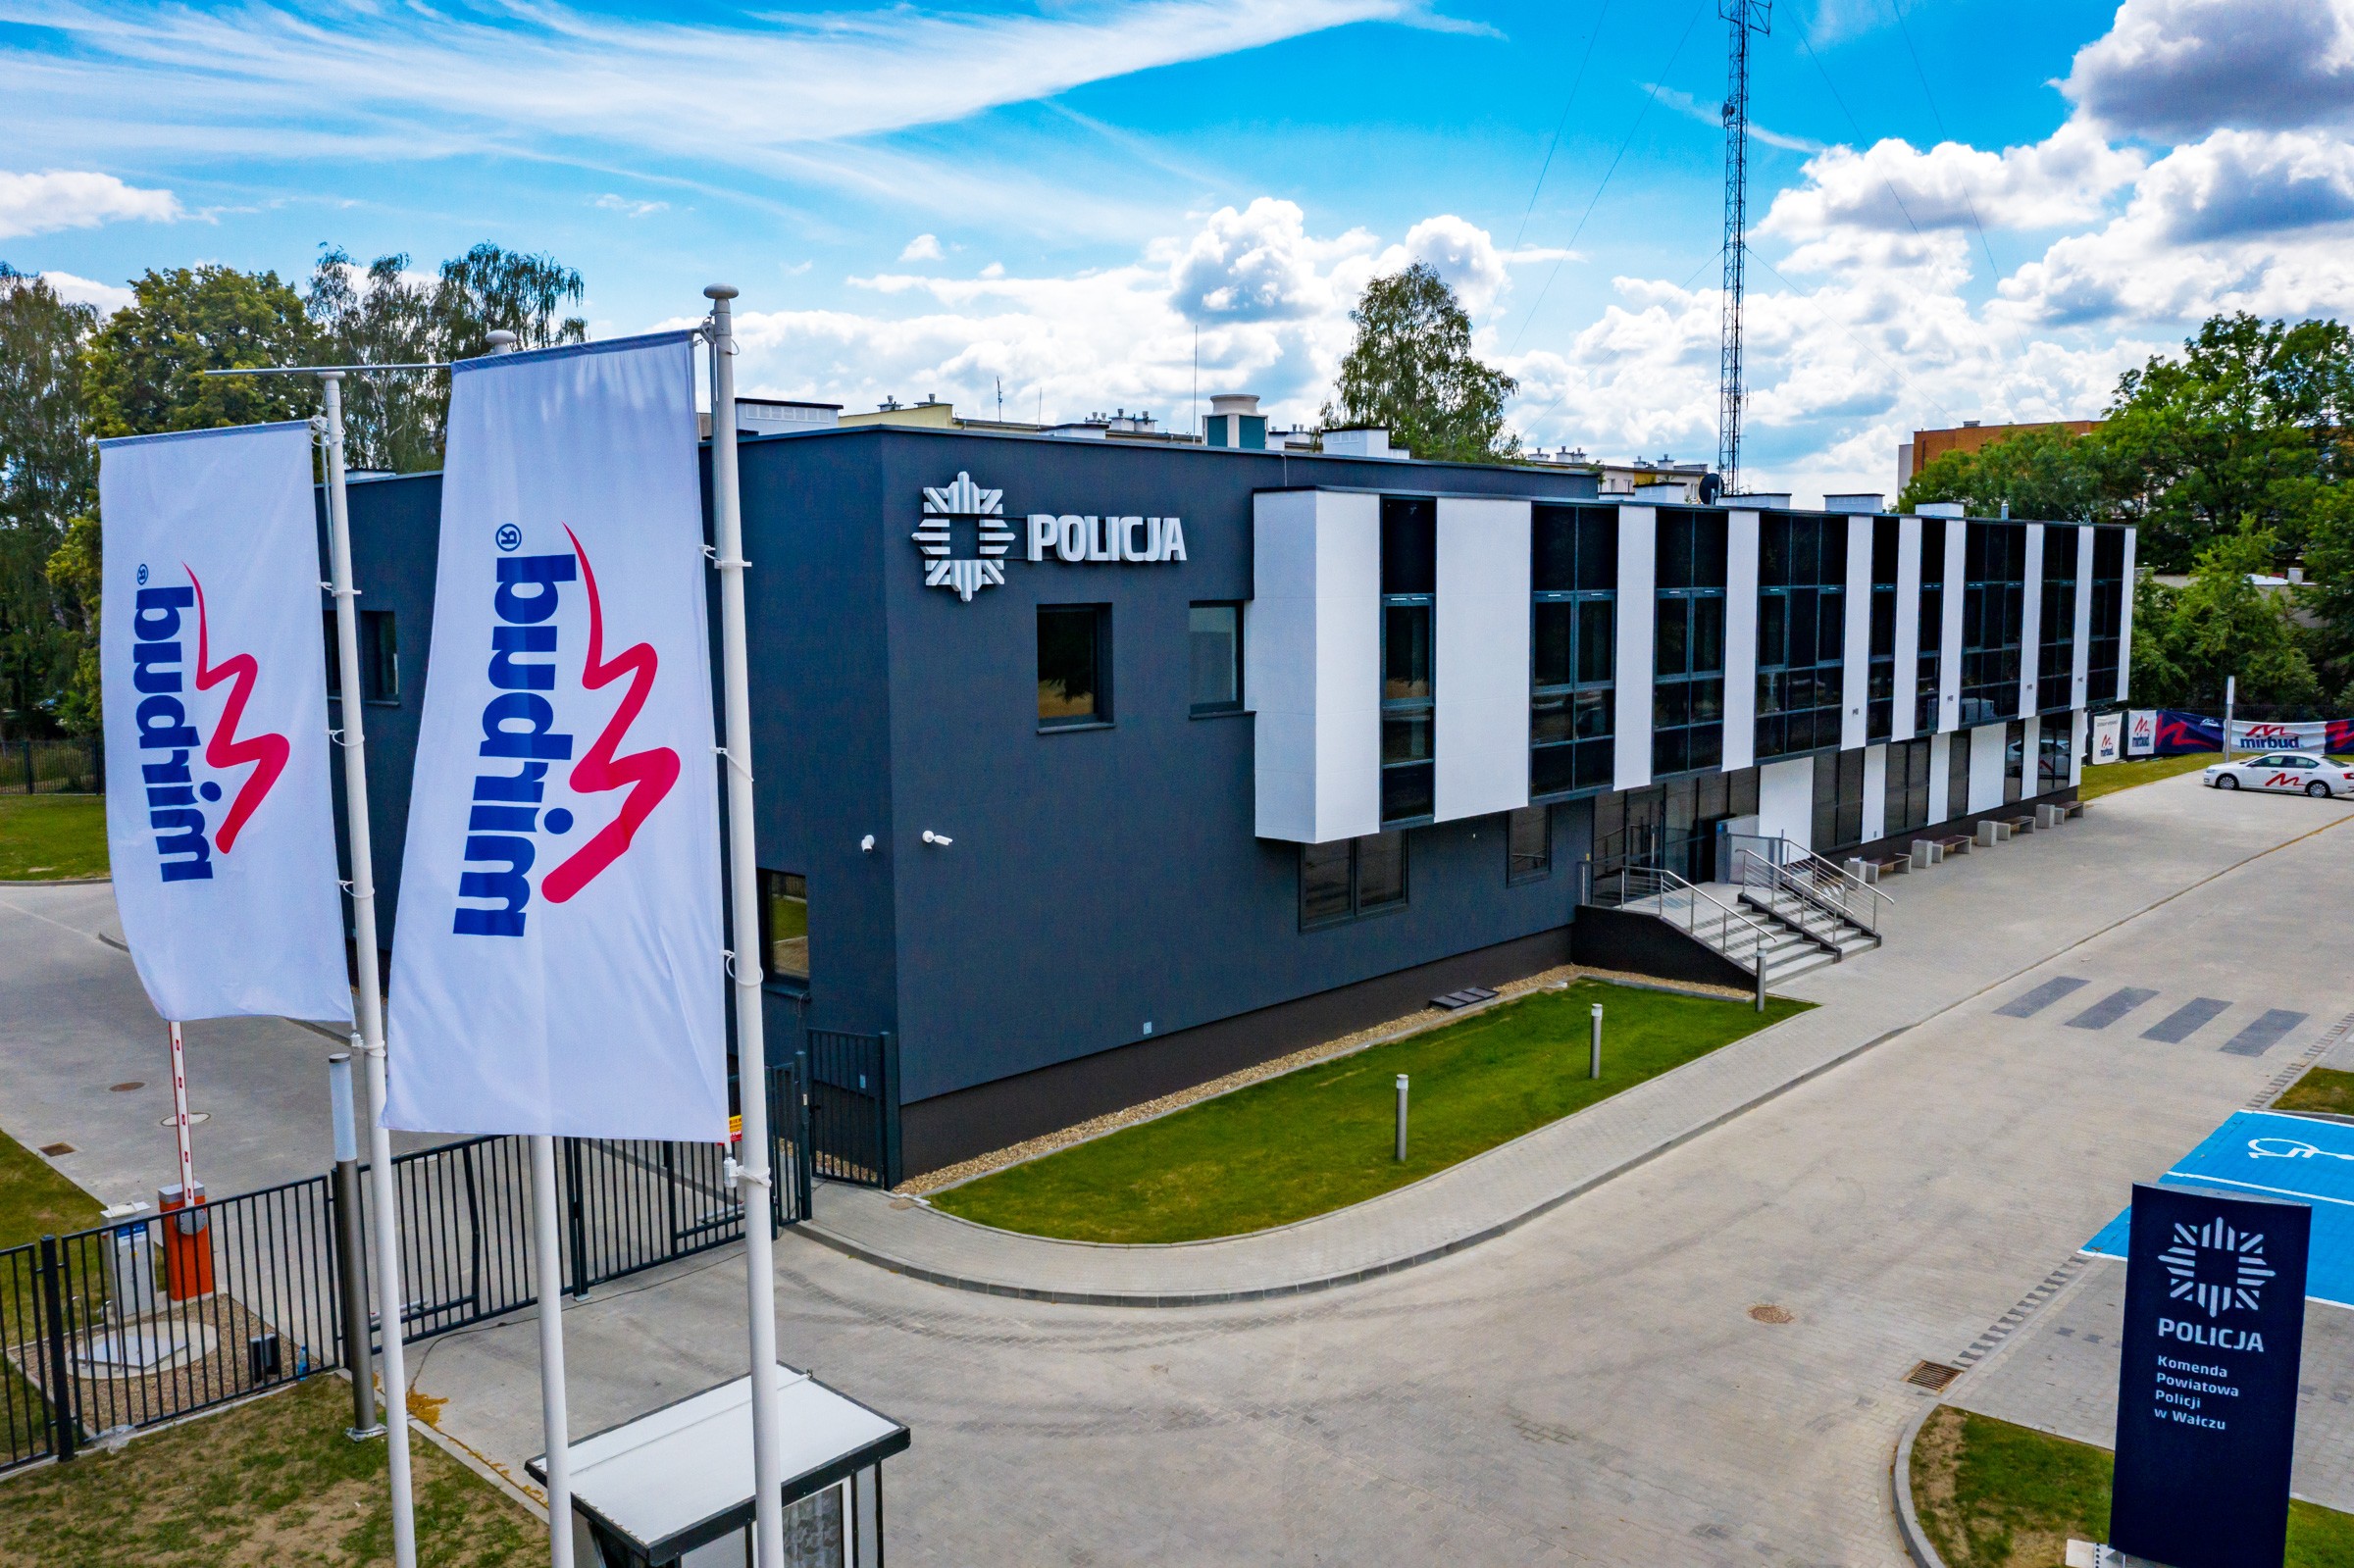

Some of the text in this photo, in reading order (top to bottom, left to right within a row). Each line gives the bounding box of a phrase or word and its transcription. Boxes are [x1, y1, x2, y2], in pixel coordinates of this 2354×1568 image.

[1027, 514, 1188, 562] POLICJA
[2240, 735, 2300, 749] mirbud
[2157, 1317, 2265, 1353] POLICJA
[2157, 1354, 2227, 1378] Komenda
[2156, 1372, 2239, 1397] Powiatowa
[2155, 1389, 2201, 1410] Policji
[2154, 1408, 2226, 1431] w Wałczu
